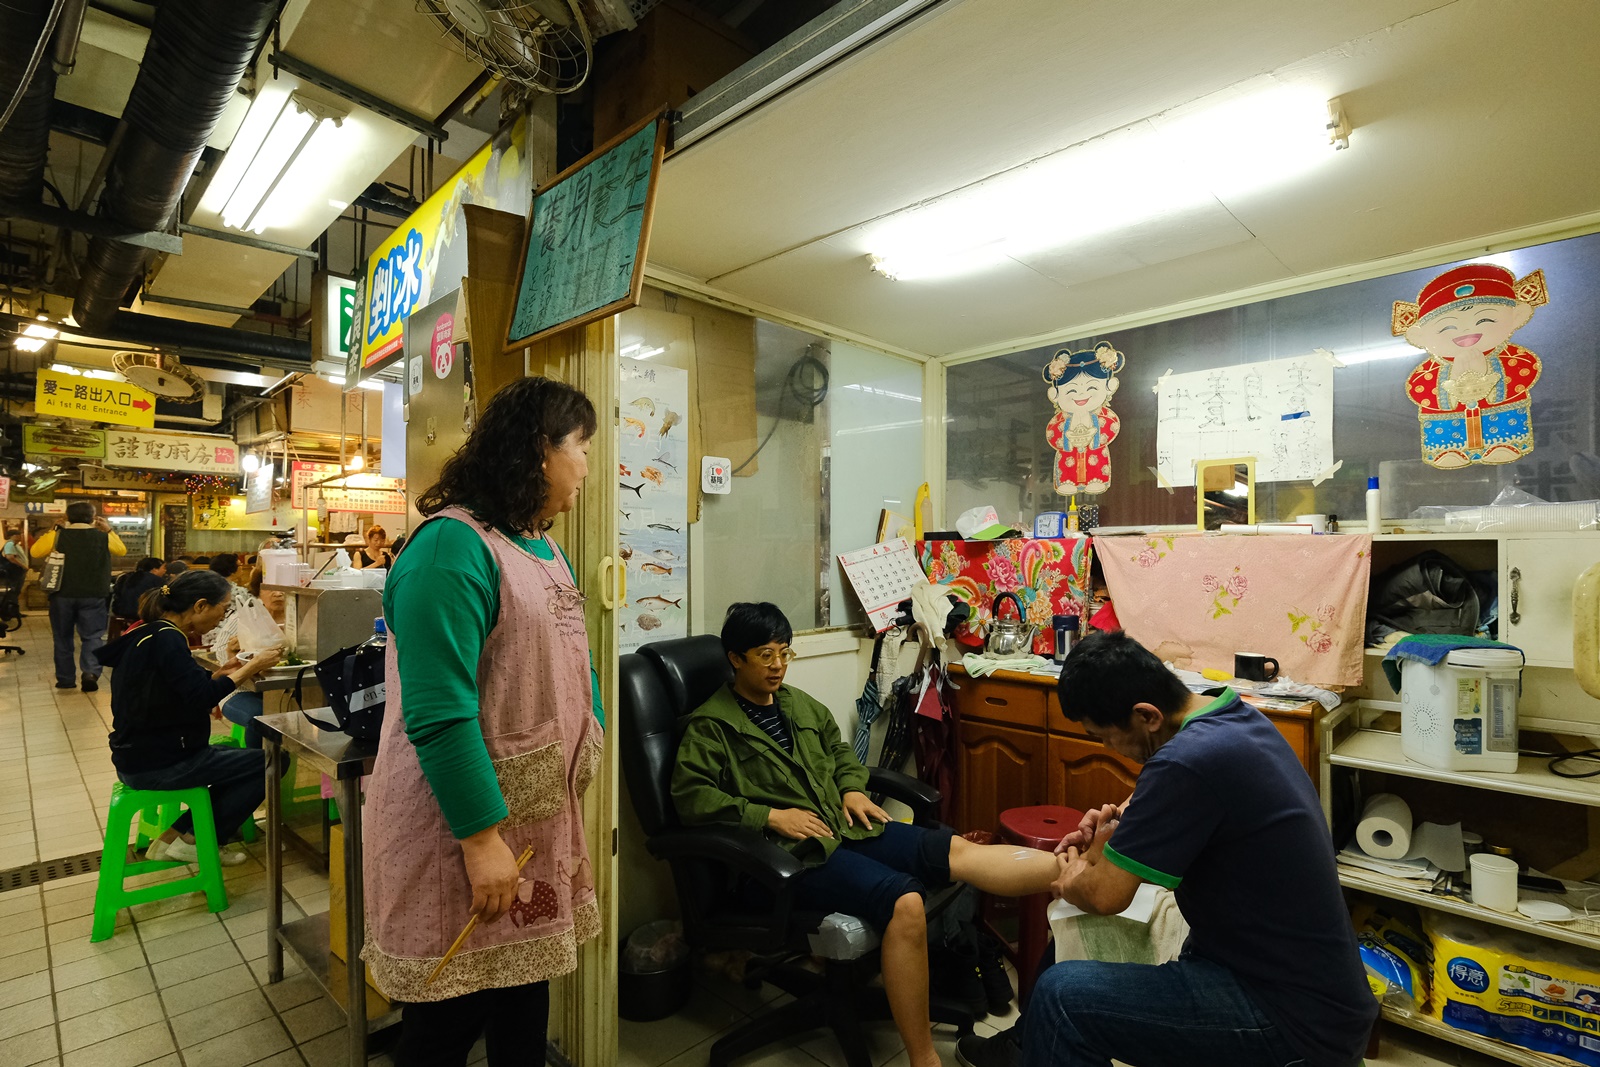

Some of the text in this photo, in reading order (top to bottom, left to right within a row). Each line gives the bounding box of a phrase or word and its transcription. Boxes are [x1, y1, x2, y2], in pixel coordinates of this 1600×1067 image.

[369, 237, 420, 337] 剉冰
[43, 379, 131, 406] 愛一路出入口
[60, 401, 72, 409] 1st
[75, 403, 89, 411] Rd.
[93, 405, 128, 416] Entrance
[46, 565, 60, 588] Roots
[1450, 963, 1485, 988] 得意
